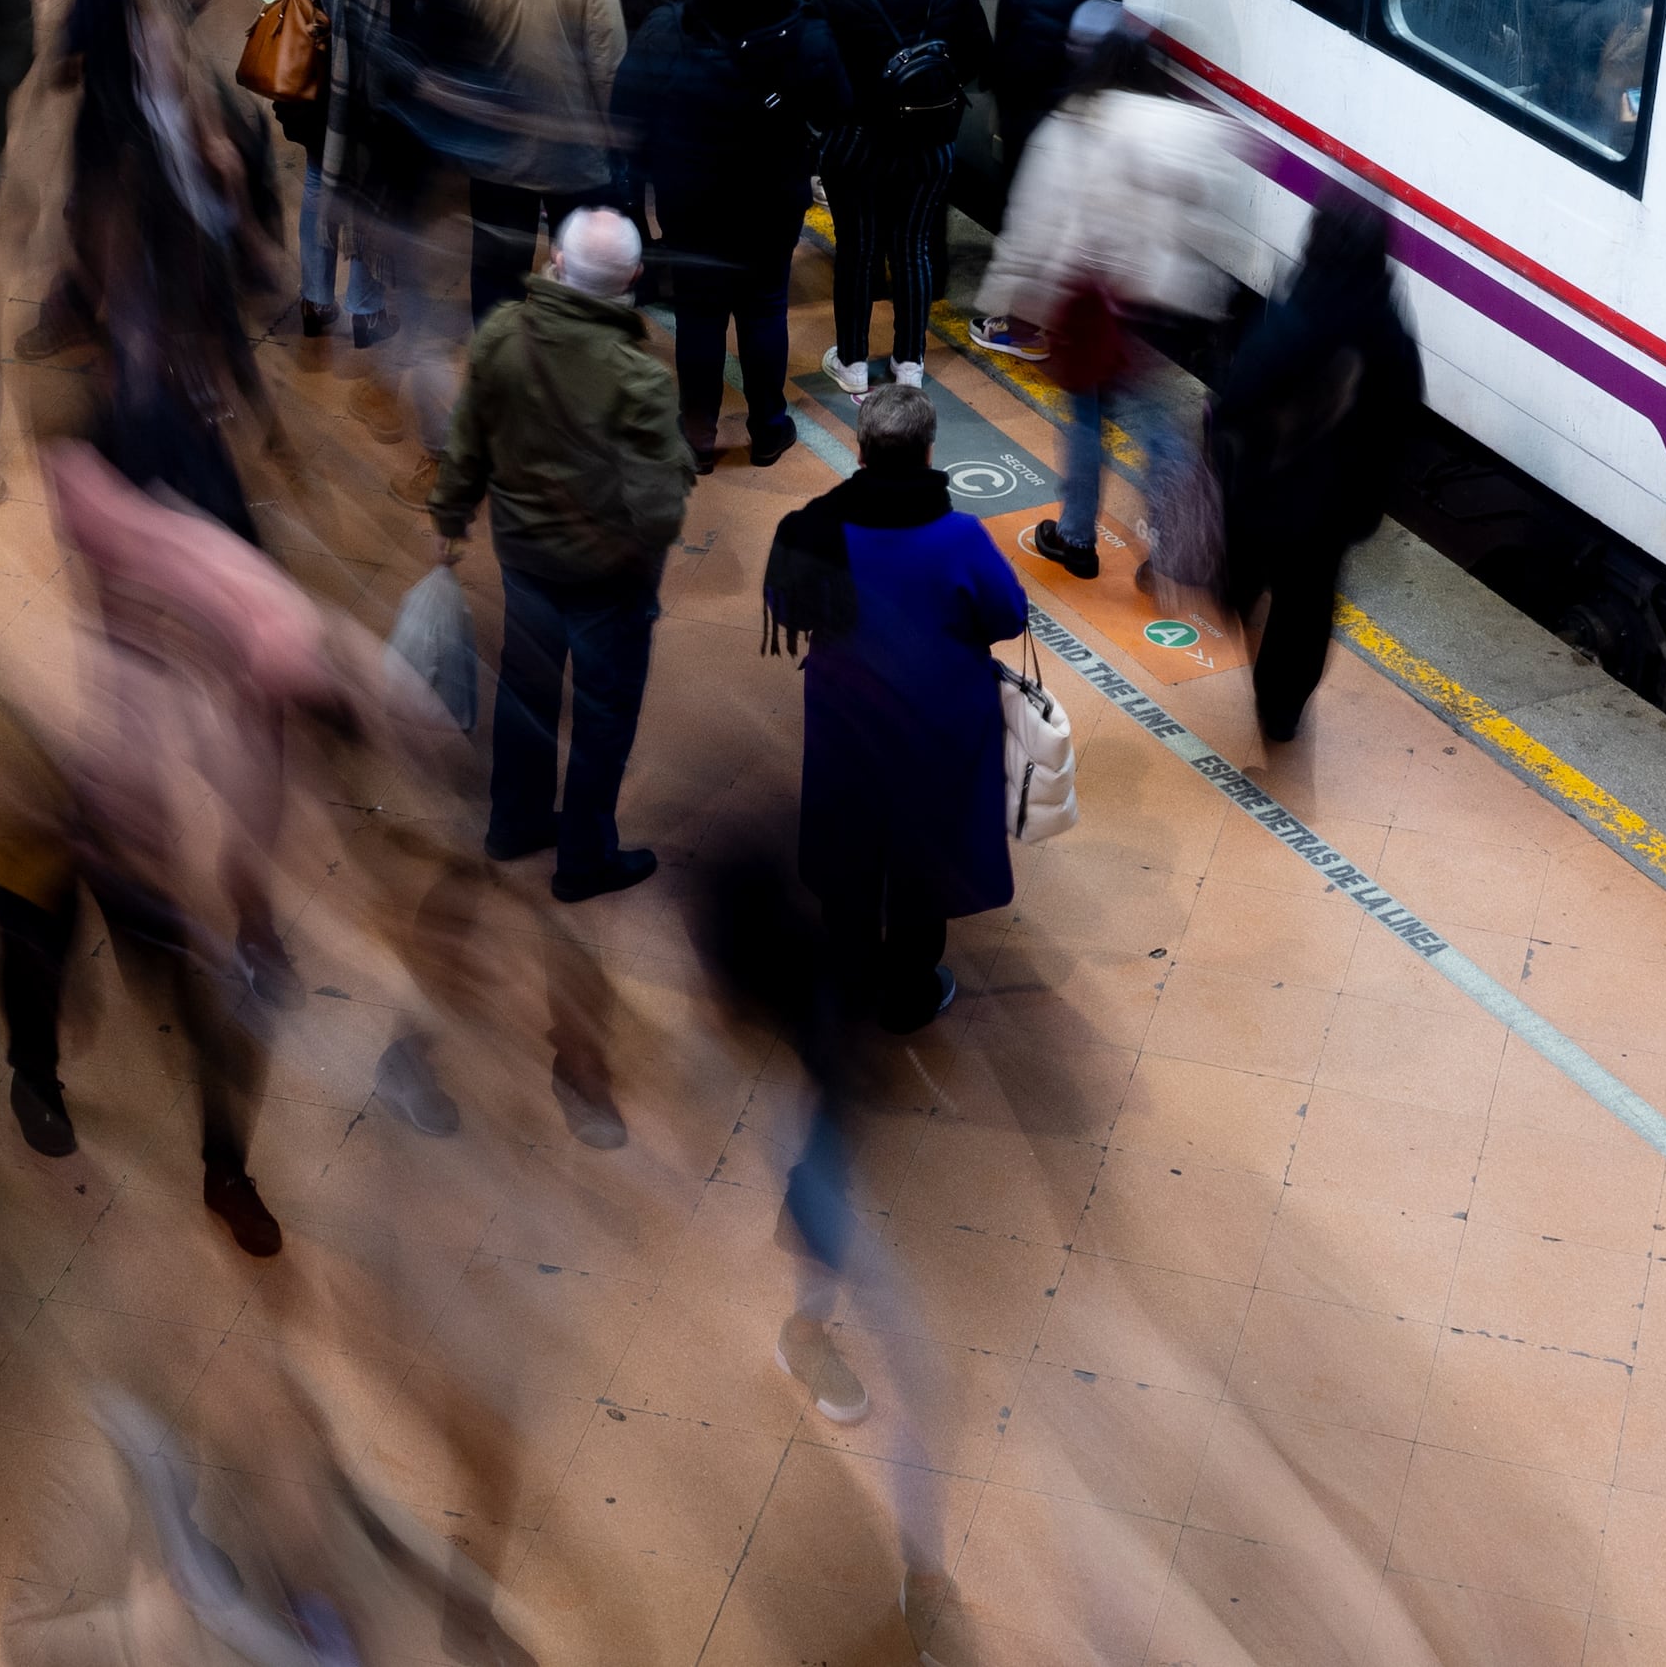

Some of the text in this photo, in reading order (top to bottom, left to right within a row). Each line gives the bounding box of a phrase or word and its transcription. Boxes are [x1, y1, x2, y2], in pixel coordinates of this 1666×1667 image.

[952, 467, 1006, 492] C
[1000, 452, 1046, 487] SECTOR
[1095, 520, 1127, 550] CTOR
[1147, 622, 1191, 646] A
[1082, 661, 1138, 704] THE
[1124, 696, 1187, 739] LINE
[1190, 754, 1449, 959] ESPERE DETRAS DE LA LINEA
